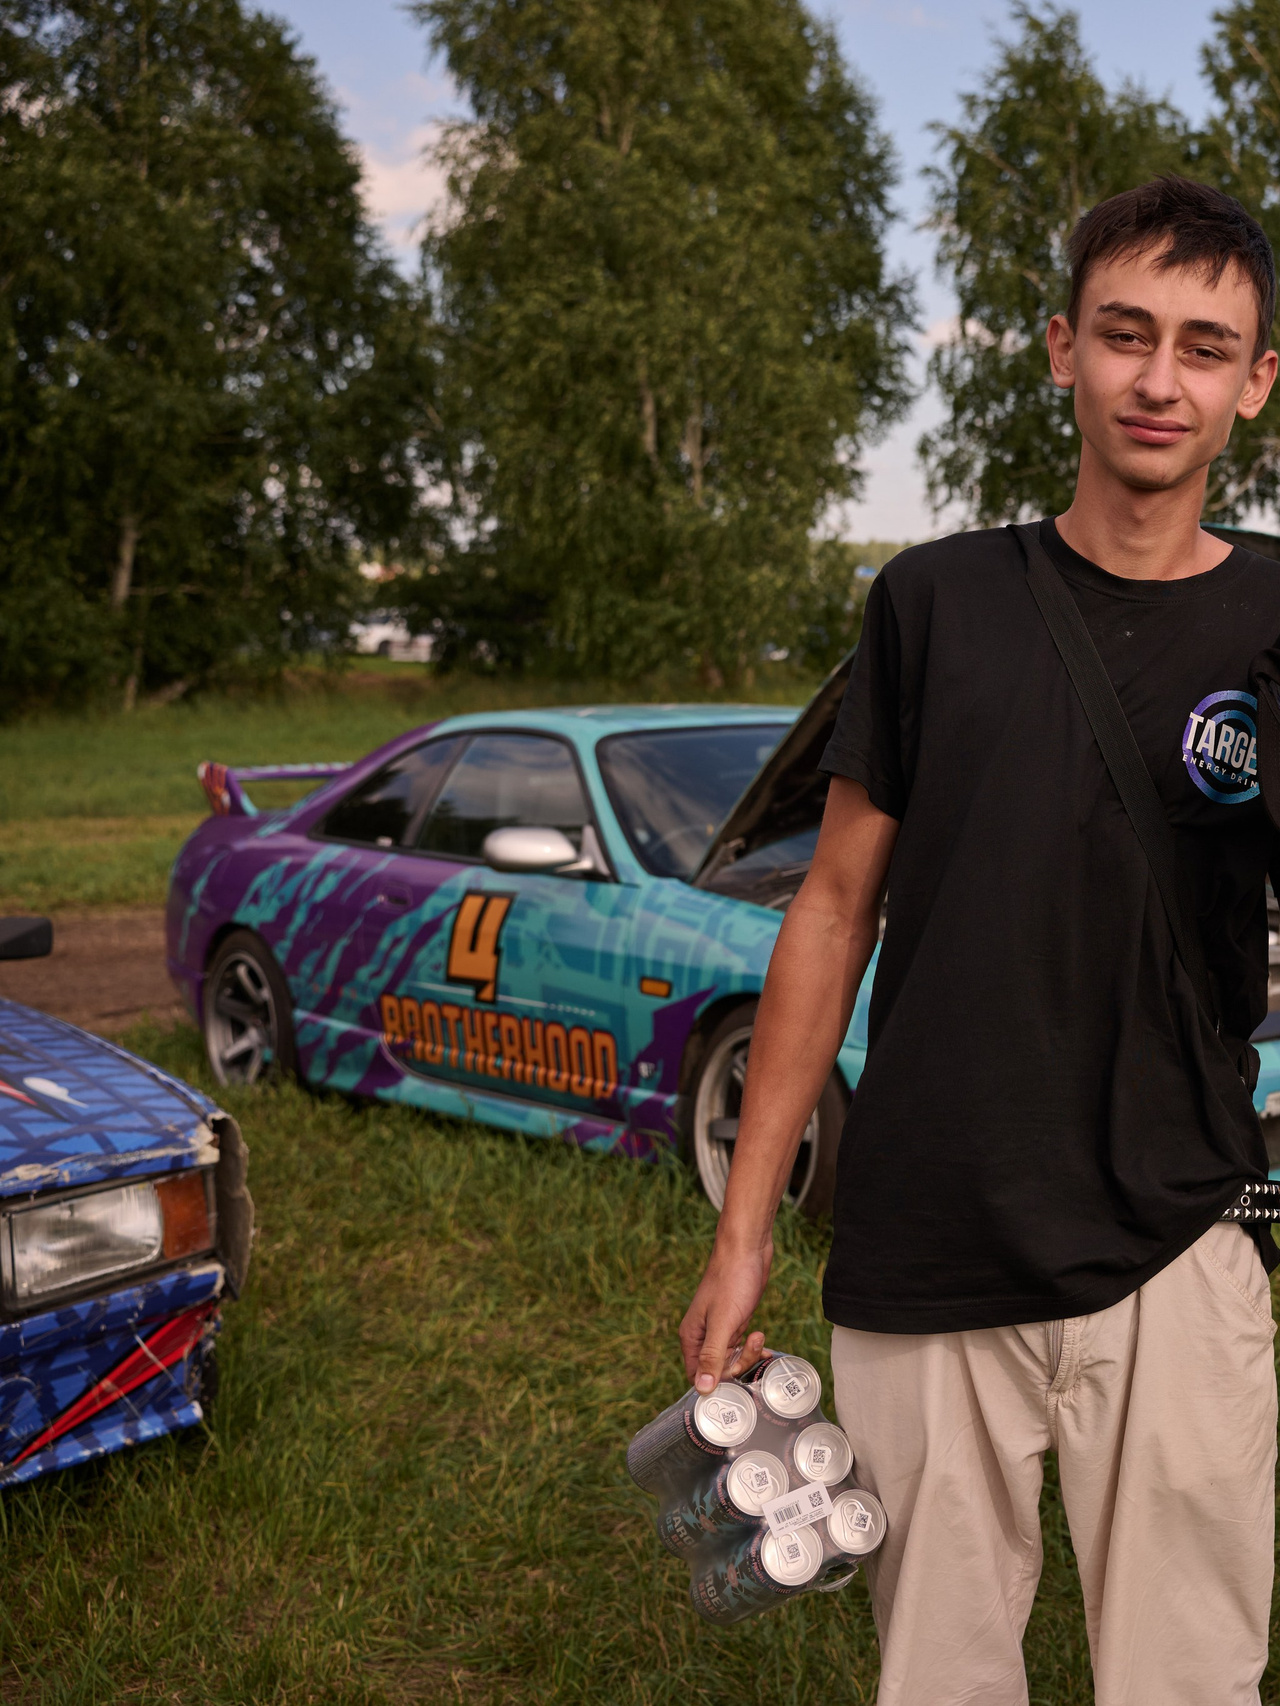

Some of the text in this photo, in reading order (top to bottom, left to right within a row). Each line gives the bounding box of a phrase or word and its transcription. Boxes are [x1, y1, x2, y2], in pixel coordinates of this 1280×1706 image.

[1182, 753, 1227, 776] ENERGY
[446, 889, 517, 1004] 4
[381, 993, 619, 1100] BROTHERHOOD
